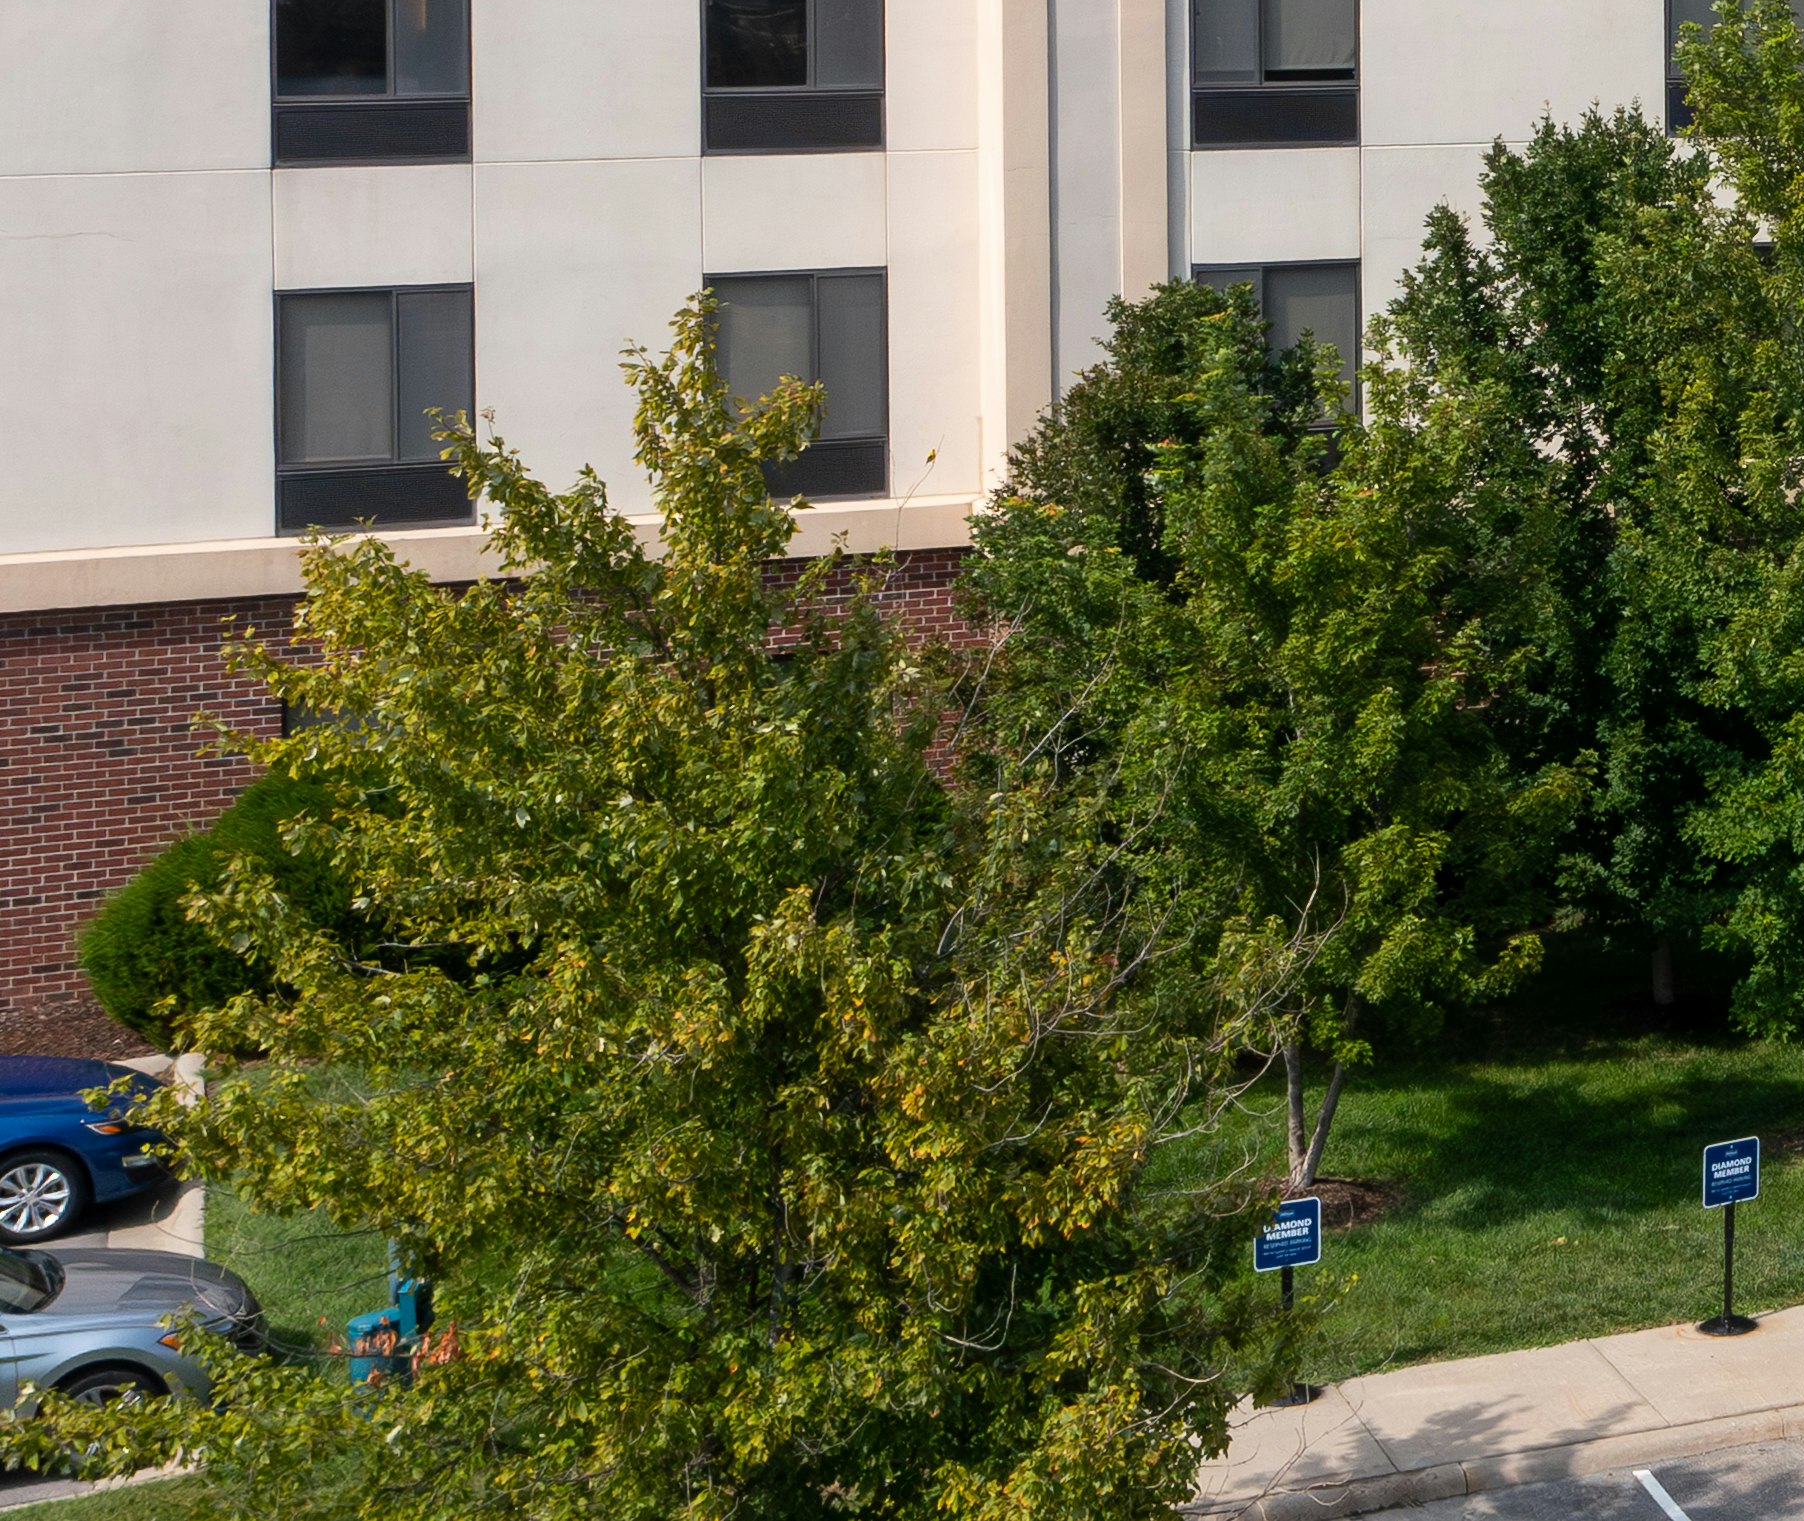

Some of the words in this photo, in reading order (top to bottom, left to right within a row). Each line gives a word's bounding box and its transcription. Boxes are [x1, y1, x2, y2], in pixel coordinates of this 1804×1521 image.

[1711, 1156, 1752, 1171] DIAMOND
[1713, 1165, 1750, 1179] MEMBER
[1263, 1218, 1312, 1233] DAMOND
[1266, 1227, 1309, 1241] MEMBER
